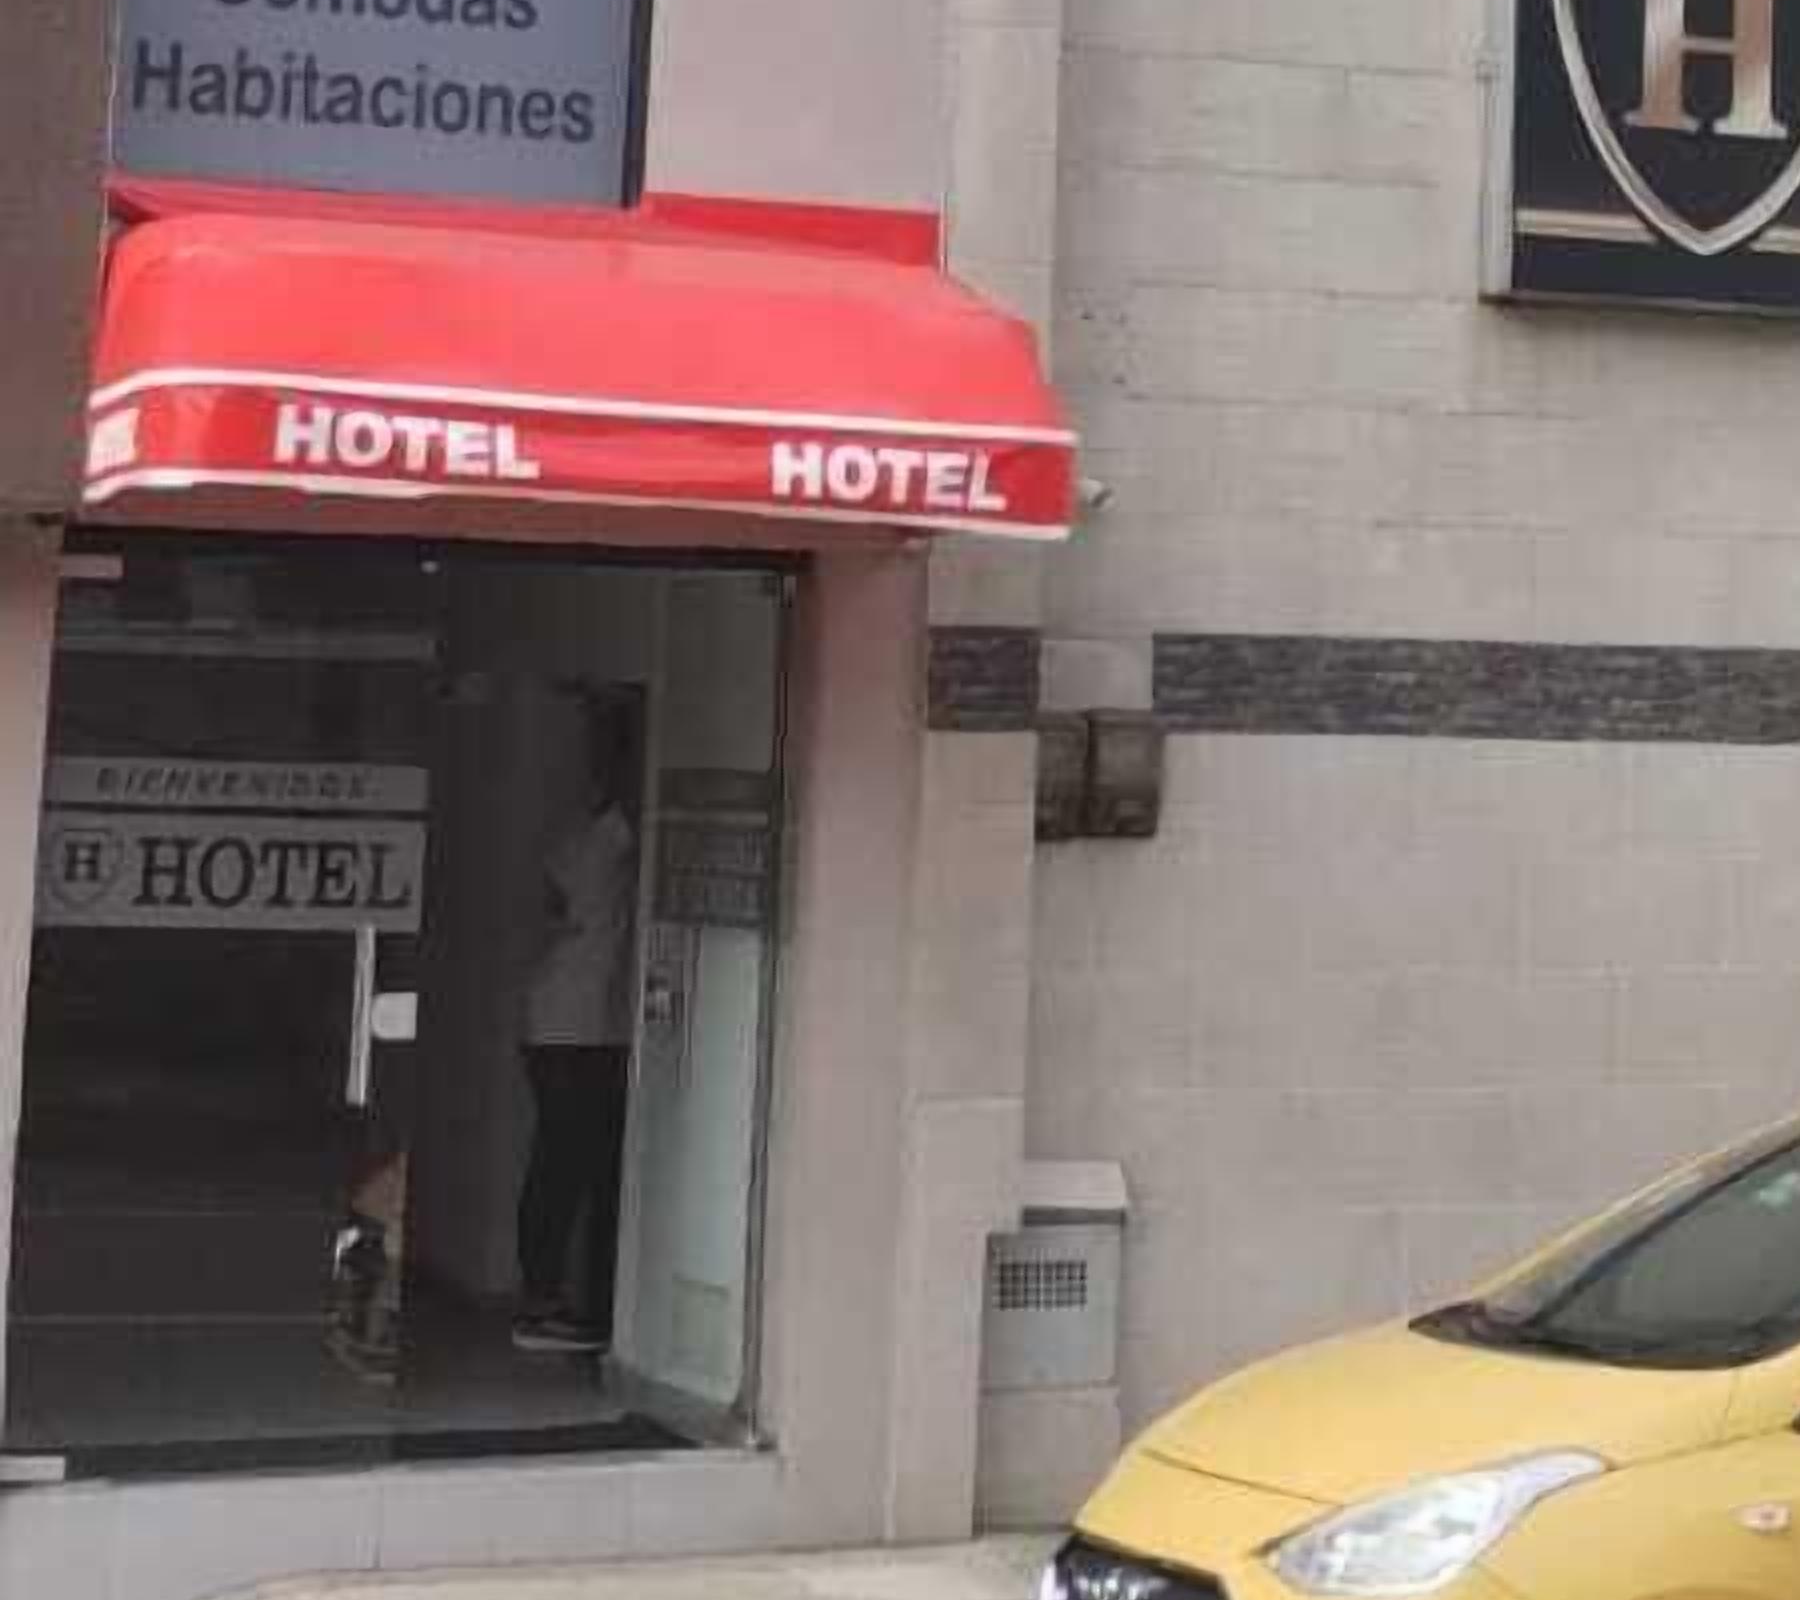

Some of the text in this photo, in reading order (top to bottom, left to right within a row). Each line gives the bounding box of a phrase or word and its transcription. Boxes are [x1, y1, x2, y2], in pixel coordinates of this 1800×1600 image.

[134, 40, 597, 144] Habitaciones
[271, 402, 540, 480] HOTEL
[771, 441, 1007, 512] HOTEL
[64, 836, 412, 909] H HOTEL
